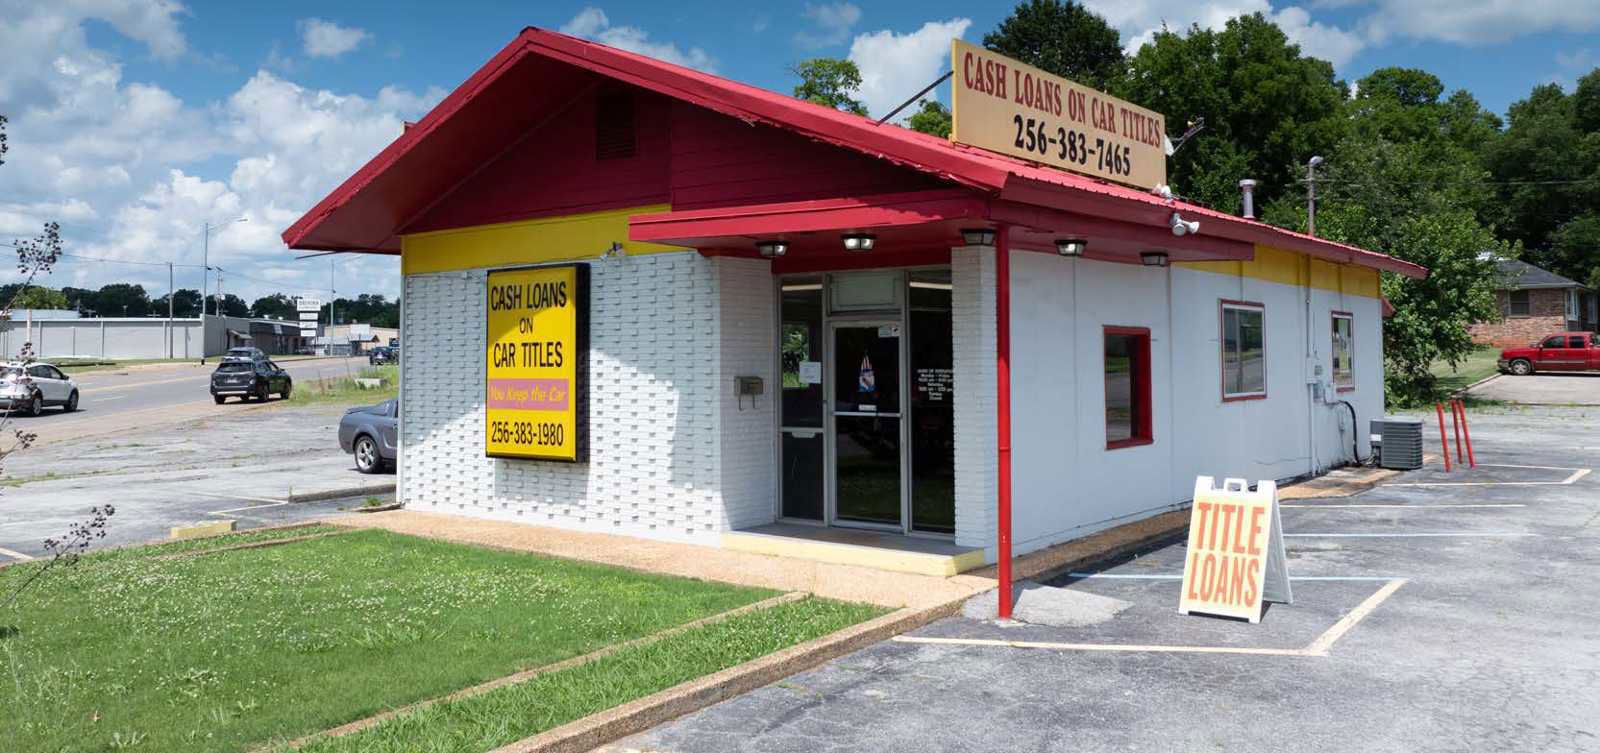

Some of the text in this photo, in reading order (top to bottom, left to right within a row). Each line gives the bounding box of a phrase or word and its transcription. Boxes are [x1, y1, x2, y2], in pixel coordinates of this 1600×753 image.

[964, 52, 1160, 148] CASH LOANS ON CAR TITLES
[1014, 114, 1131, 176] 256-383-7465
[491, 281, 567, 311] CASH LOANS
[519, 317, 533, 334] ON
[493, 342, 563, 368] CAR TITLES
[490, 385, 505, 401] You
[506, 385, 528, 404] Keep
[549, 384, 567, 401] Car
[491, 421, 564, 446] 256-383-1980
[1196, 502, 1265, 555] TITLE
[1188, 553, 1260, 607] LOANS
